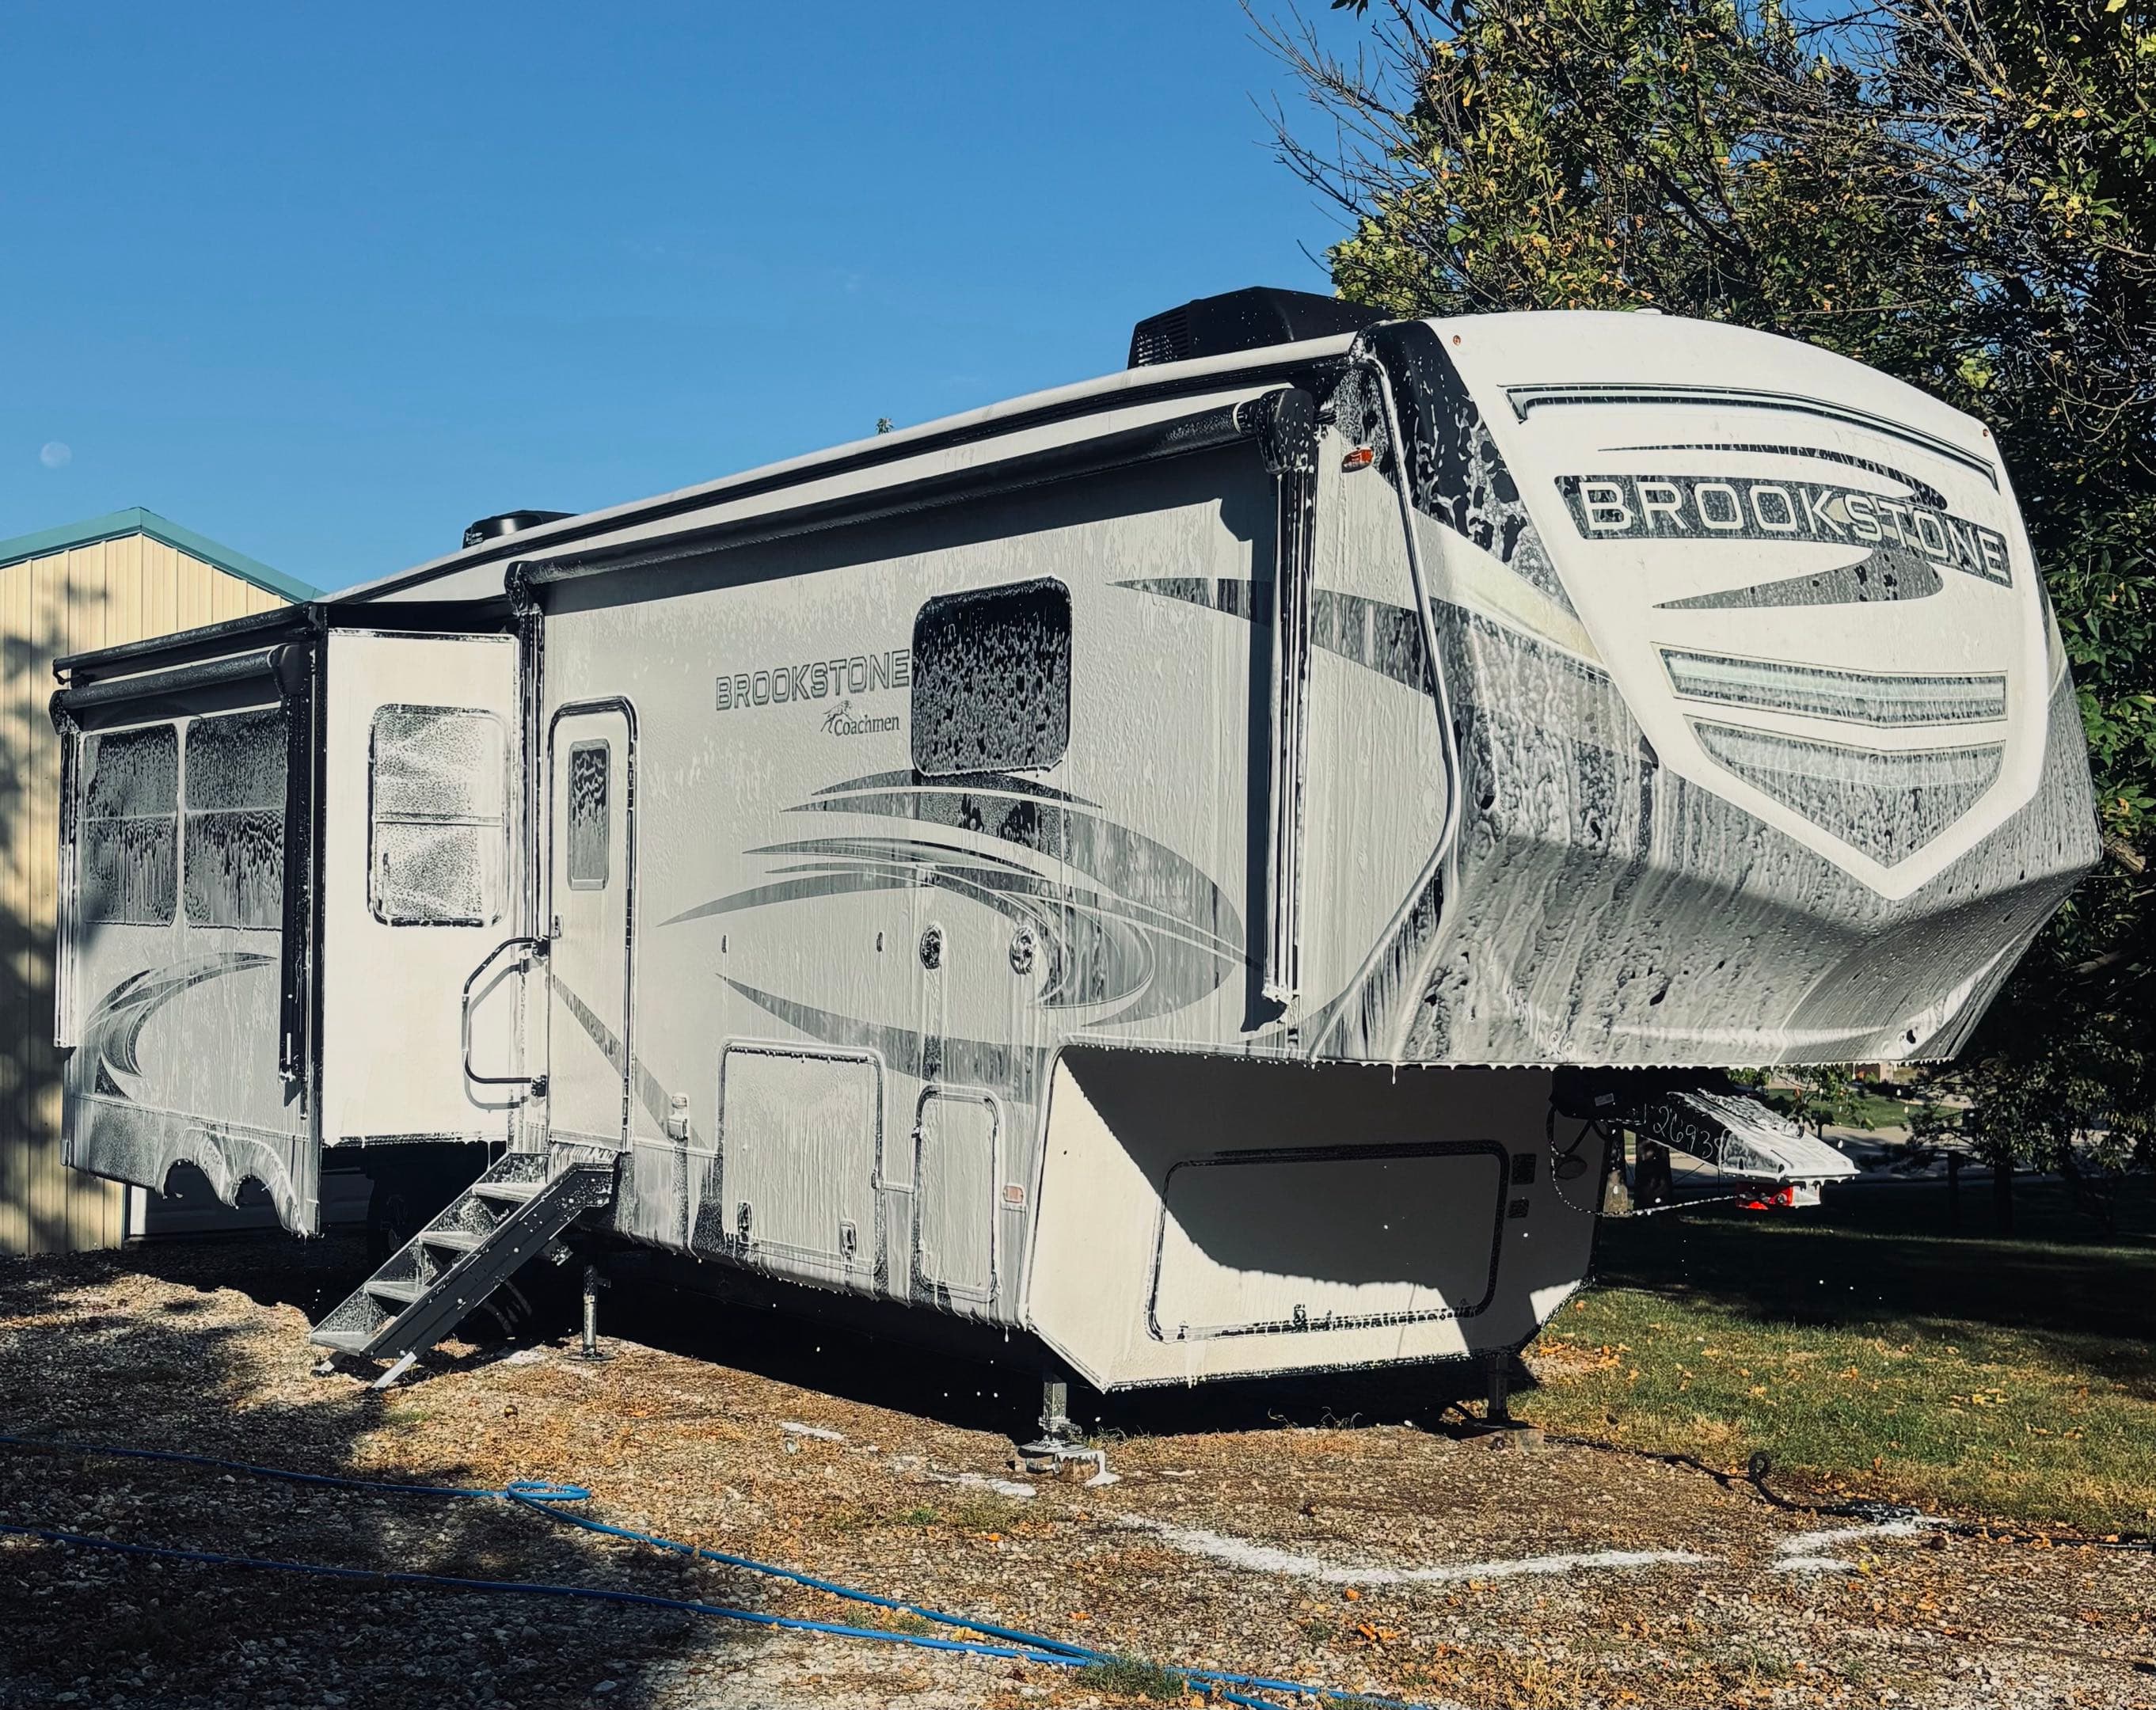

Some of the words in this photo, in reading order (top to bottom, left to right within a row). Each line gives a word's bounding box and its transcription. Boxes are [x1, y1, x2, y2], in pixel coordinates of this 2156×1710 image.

[1583, 482, 2006, 576] BROOKSTONE
[716, 648, 910, 711] BROOKSTONE
[833, 715, 899, 736] Coachmen
